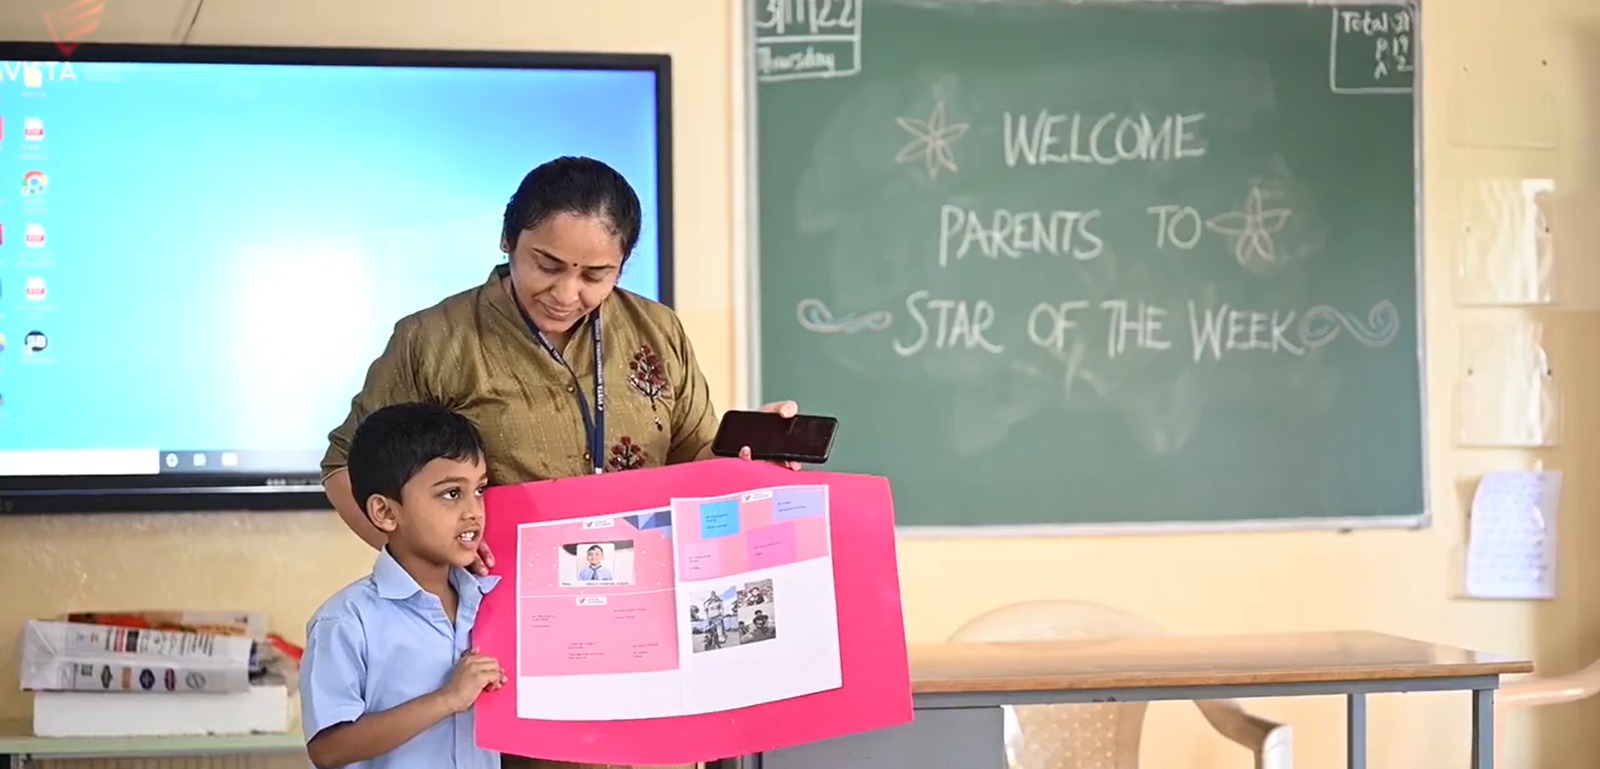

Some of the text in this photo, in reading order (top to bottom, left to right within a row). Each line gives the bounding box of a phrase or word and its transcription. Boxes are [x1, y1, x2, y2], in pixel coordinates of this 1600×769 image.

[1341, 10, 1388, 36] Total
[1003, 108, 1206, 168] WELCOME
[938, 203, 1201, 268] PARENTS TO
[893, 289, 1305, 363] STAR OF THE WEEK
